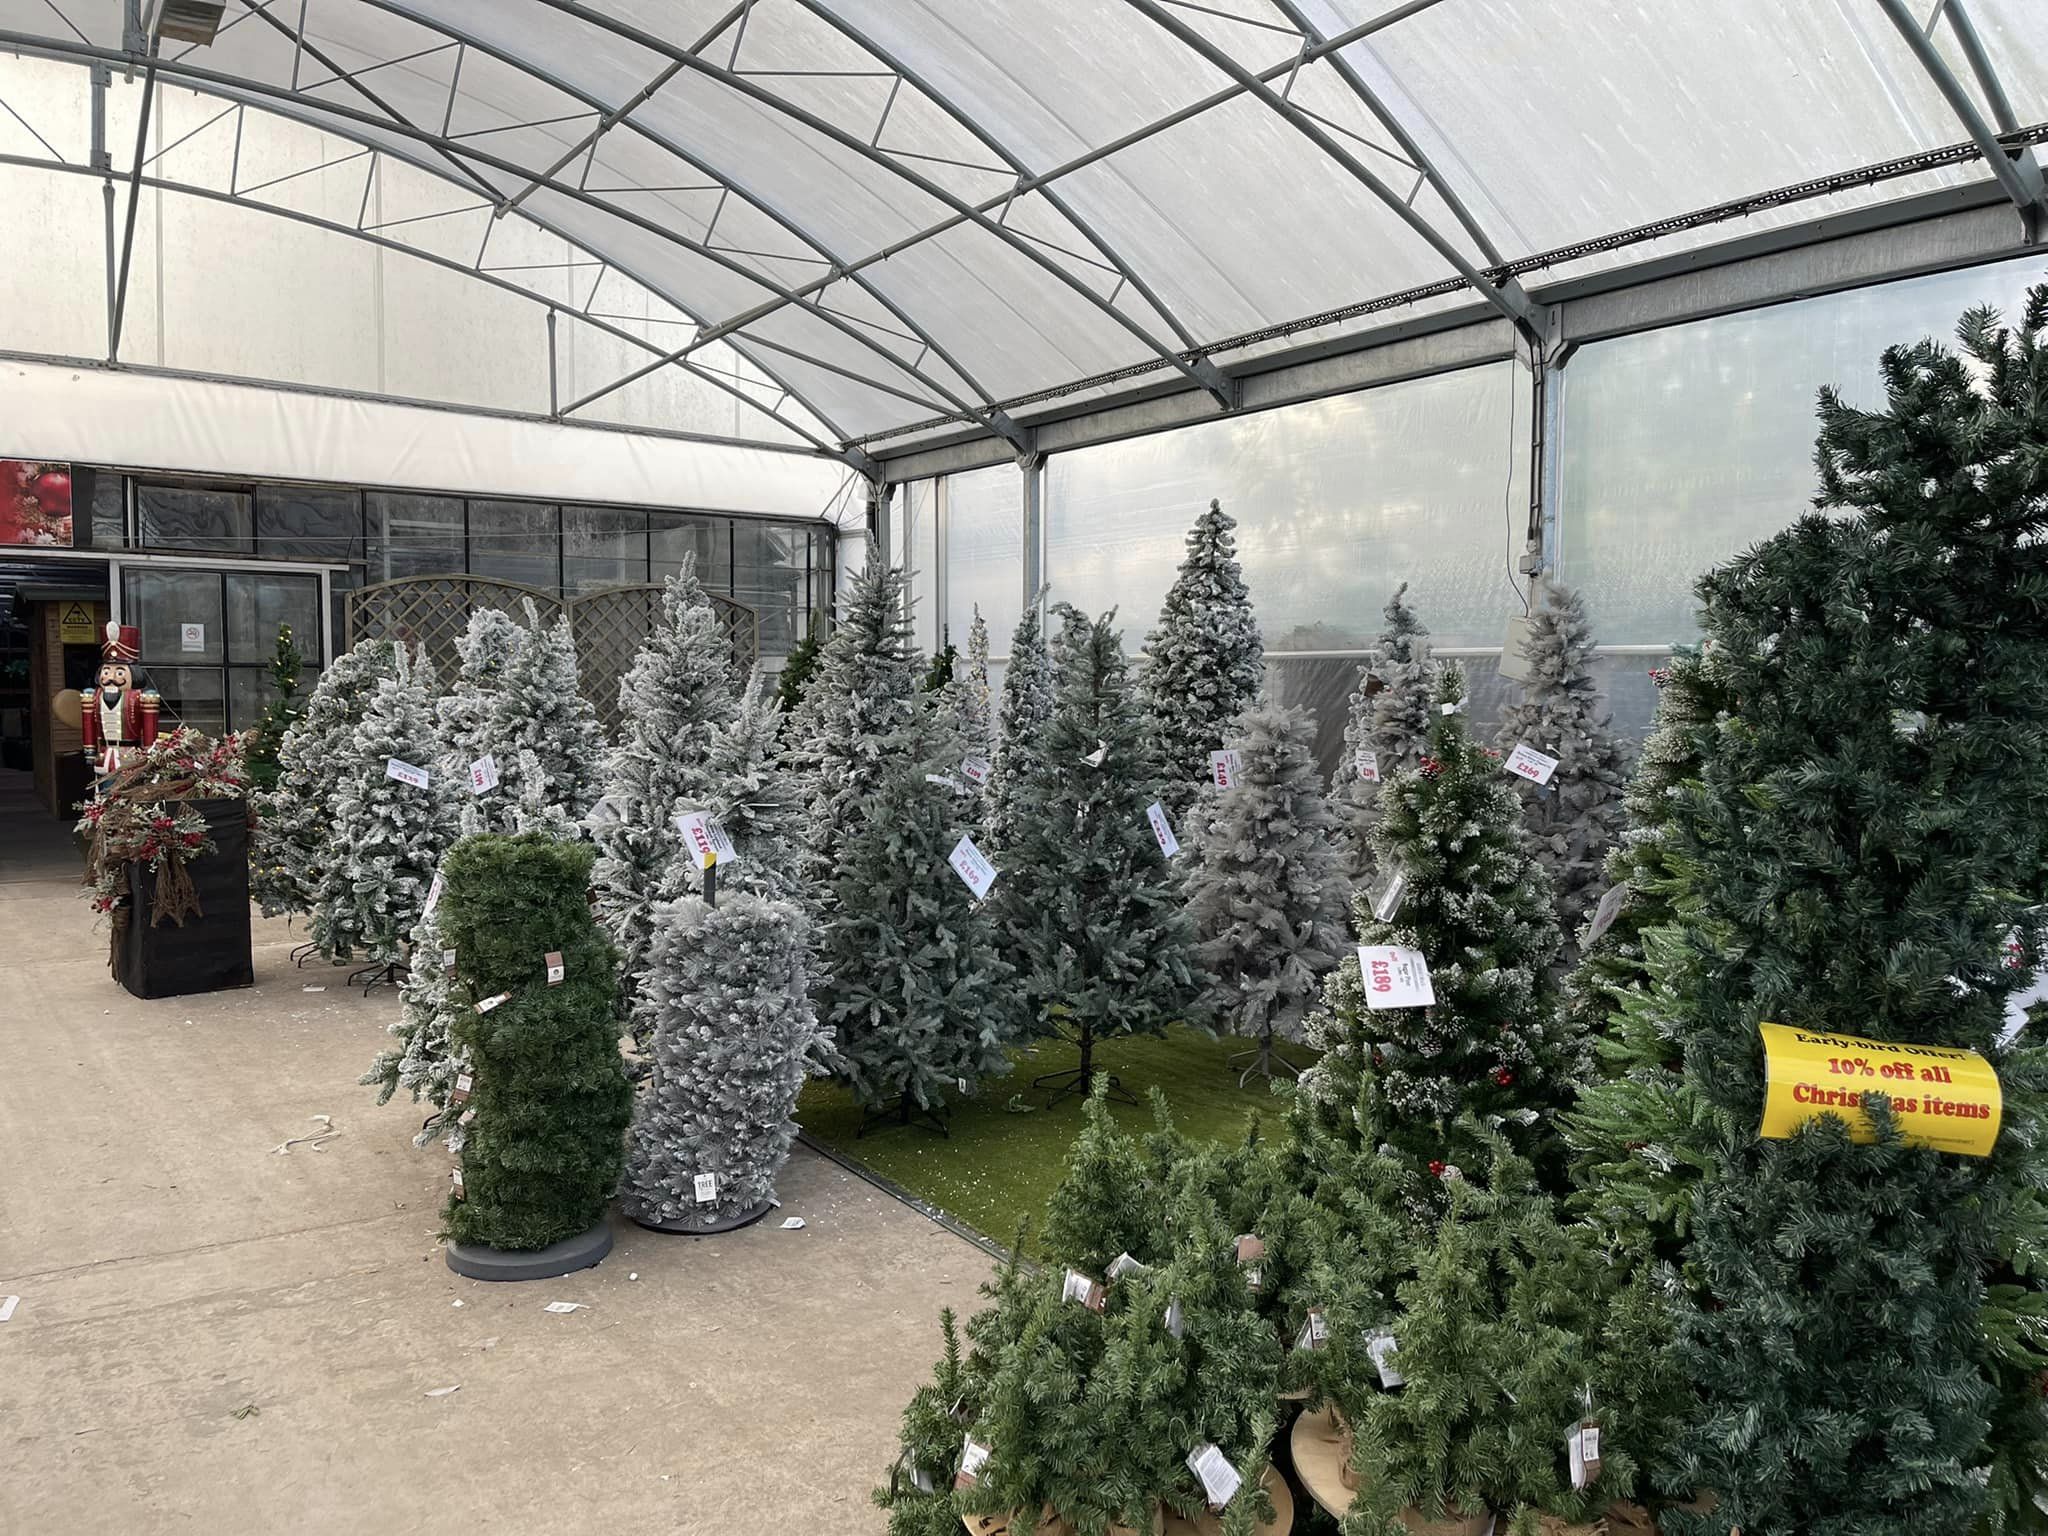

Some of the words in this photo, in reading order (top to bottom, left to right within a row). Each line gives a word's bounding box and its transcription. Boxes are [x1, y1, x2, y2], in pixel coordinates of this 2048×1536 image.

[1216, 762, 1228, 786] £149
[1517, 762, 1540, 778] £269
[1371, 960, 1392, 993] £189
[1795, 1033, 1902, 1053] Early-bird
[1827, 1057, 1876, 1077] 10%
[1880, 1061, 1915, 1081] off
[1920, 1065, 1953, 1084] all
[1793, 1082, 1919, 1113] Chrisas
[1923, 1094, 1991, 1119] items
